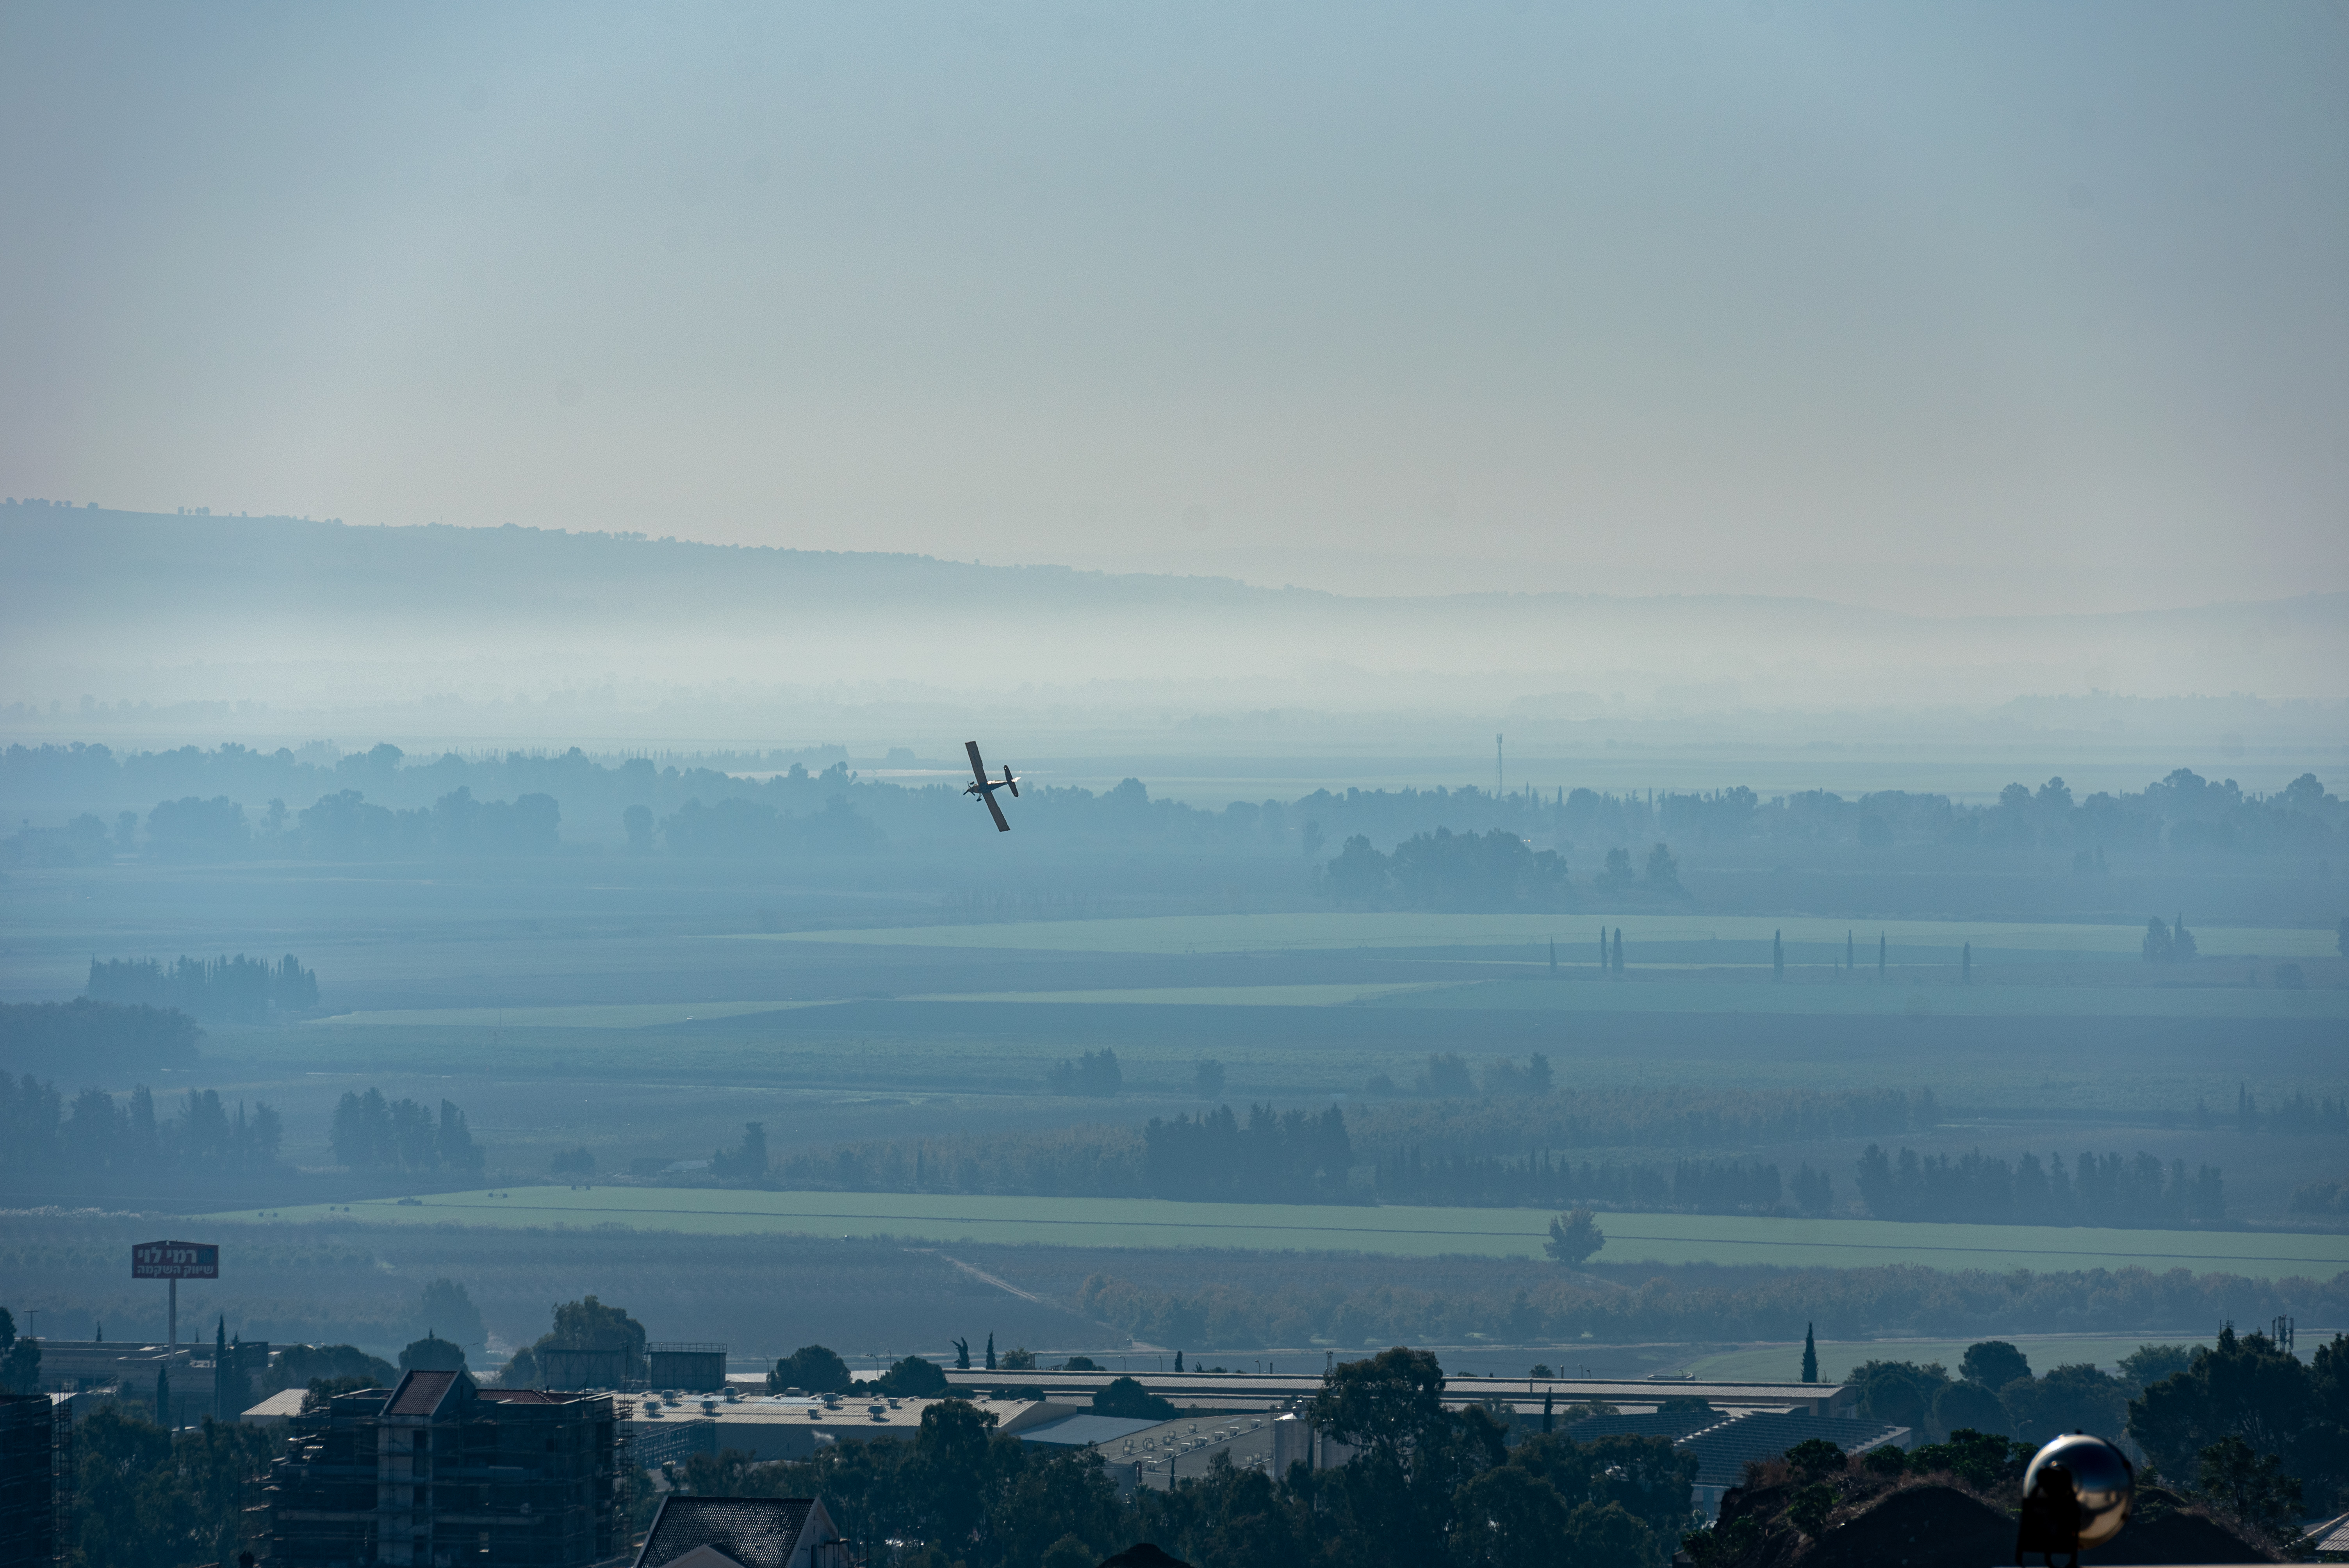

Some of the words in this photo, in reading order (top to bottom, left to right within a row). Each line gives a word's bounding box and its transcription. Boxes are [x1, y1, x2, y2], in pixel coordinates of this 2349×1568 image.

[137, 1247, 162, 1263] לוי
[166, 1249, 197, 1263] רמי
[137, 1265, 180, 1277] השקמה
[183, 1265, 214, 1277] שיווק
